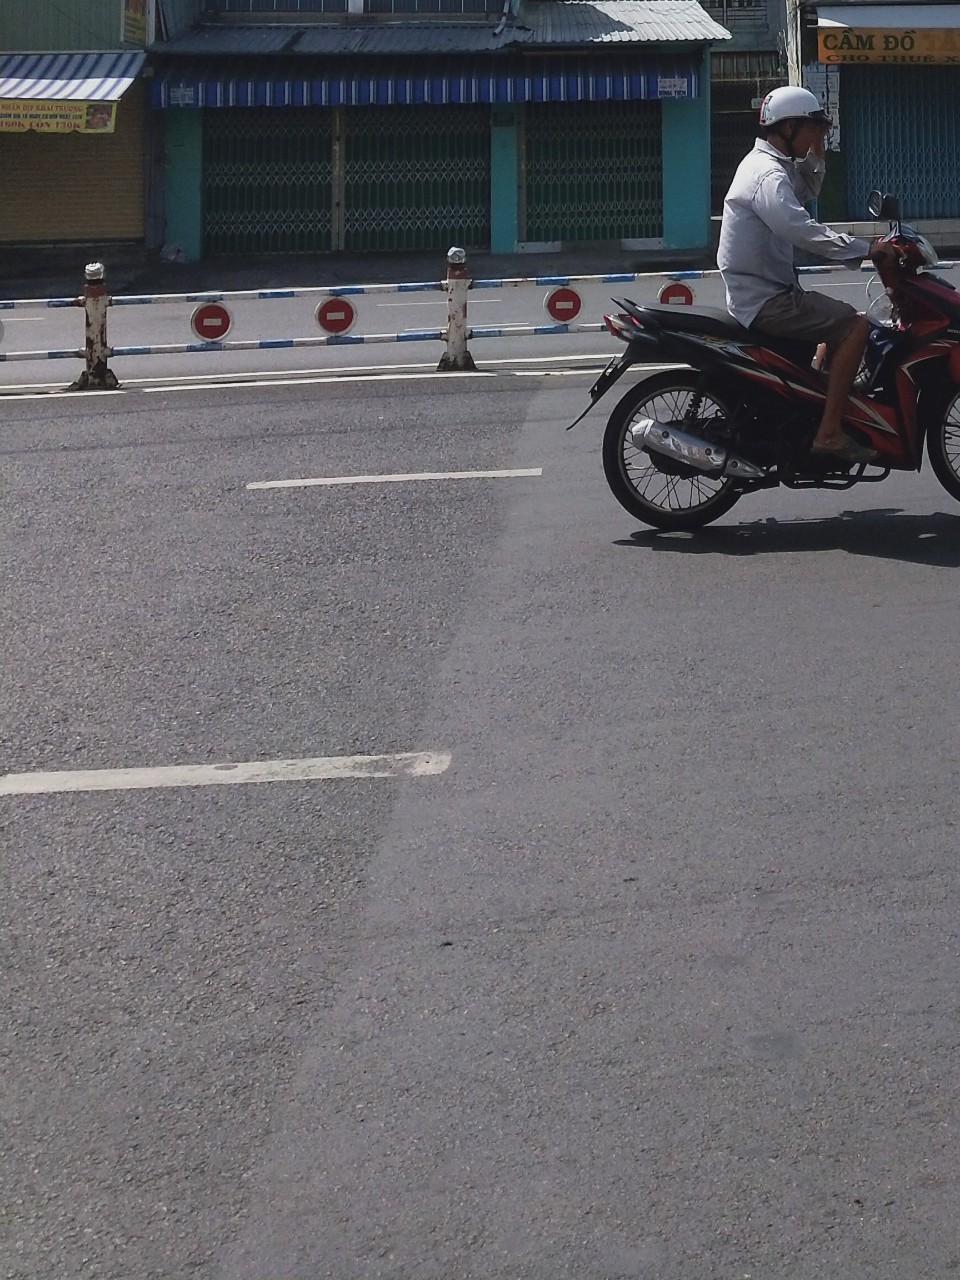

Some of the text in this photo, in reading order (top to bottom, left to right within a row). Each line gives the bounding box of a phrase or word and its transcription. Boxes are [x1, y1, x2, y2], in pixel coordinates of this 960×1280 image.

[823, 27, 875, 51] CẦM
[883, 30, 917, 51] ĐỒ
[826, 54, 870, 62] CHO
[879, 53, 936, 63] THUÊ
